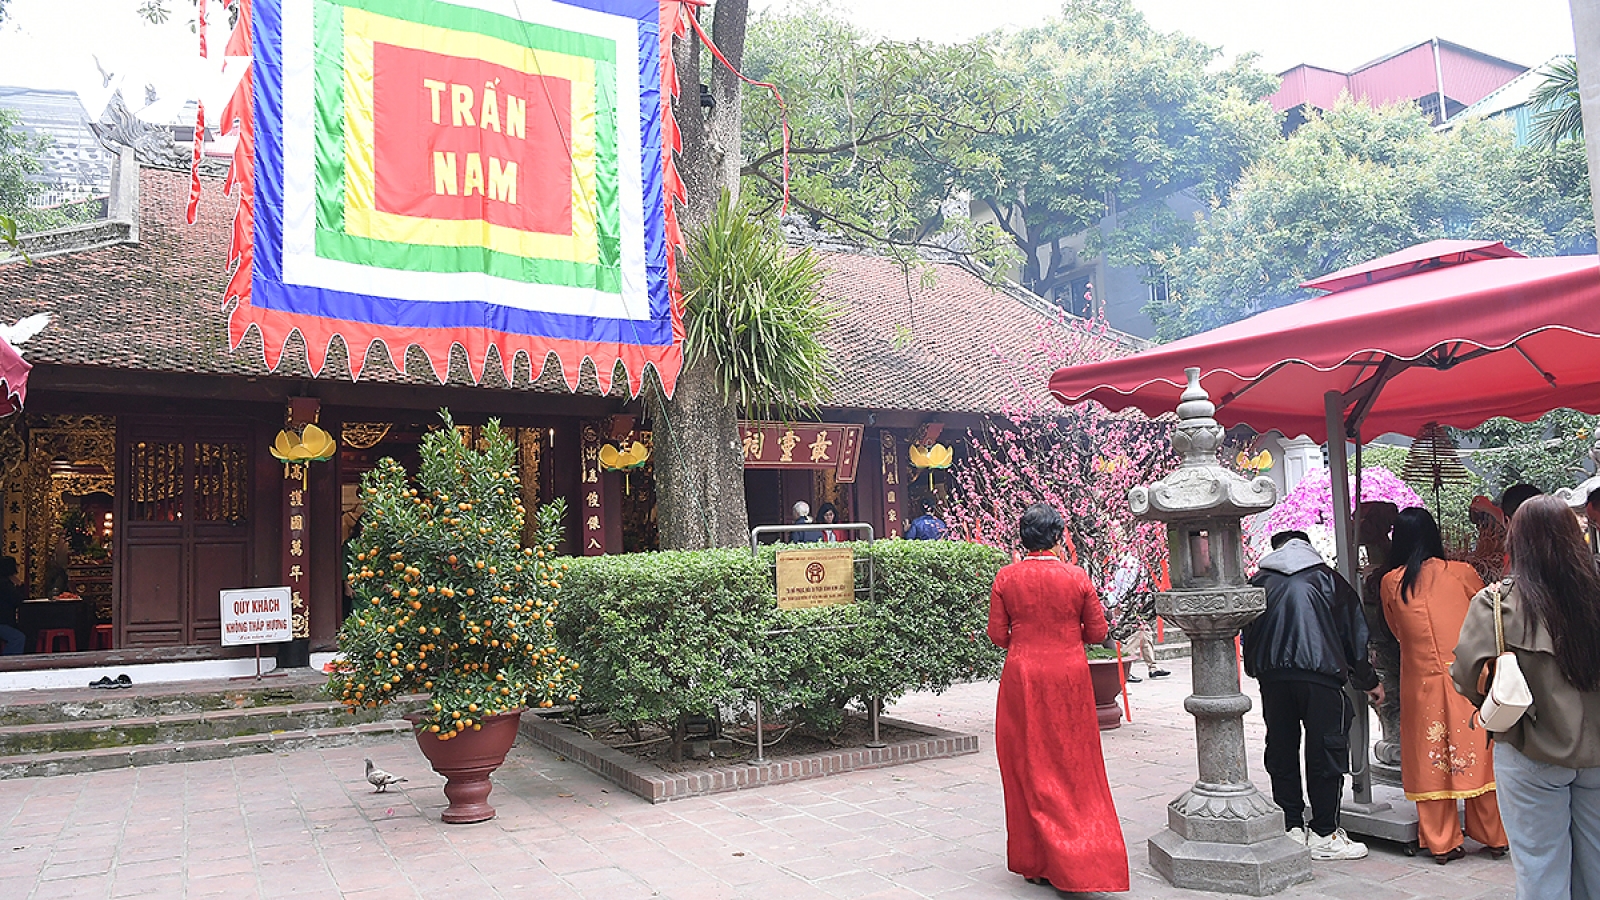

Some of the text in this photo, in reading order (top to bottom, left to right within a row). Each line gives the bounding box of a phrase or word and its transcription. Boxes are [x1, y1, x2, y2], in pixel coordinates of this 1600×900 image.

[424, 77, 526, 140] TRẤN
[434, 151, 518, 205] NAM
[251, 595, 280, 613] KHÁCH
[226, 617, 287, 633] KHÔNG THẤP HƯƠNG
